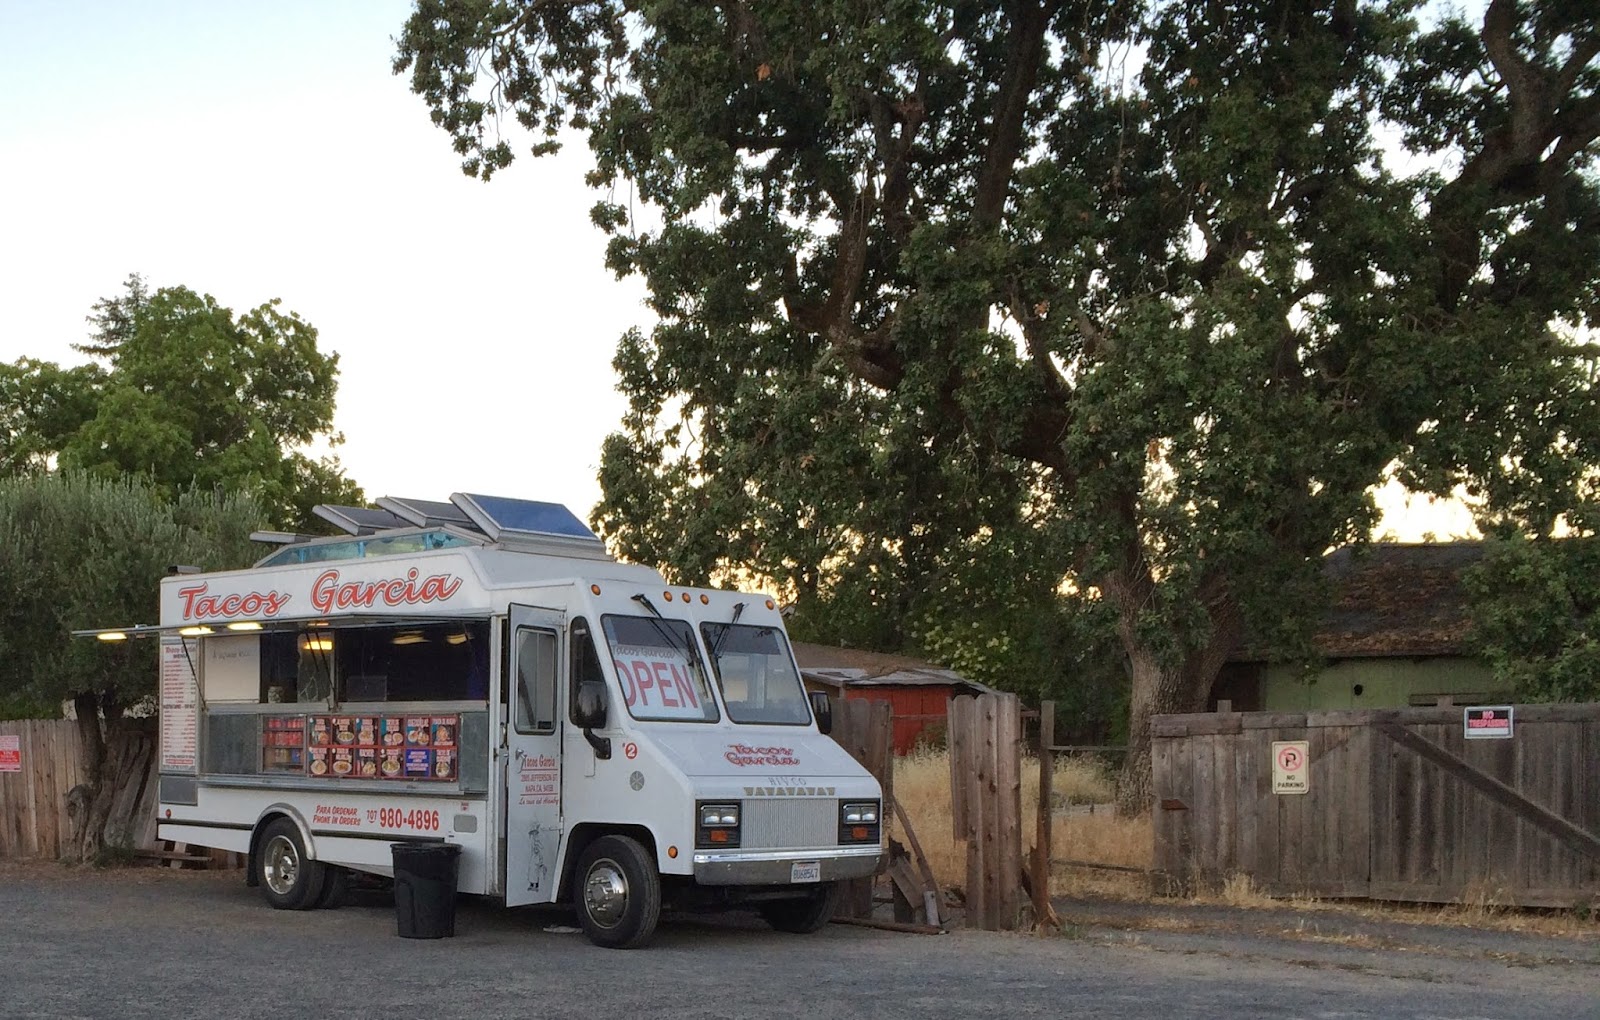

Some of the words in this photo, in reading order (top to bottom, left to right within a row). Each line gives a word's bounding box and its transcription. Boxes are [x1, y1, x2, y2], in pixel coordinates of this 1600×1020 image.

[178, 581, 292, 620] Tacos
[310, 567, 464, 615] Garcia
[615, 660, 698, 708] OPEN
[1482, 710, 1494, 719] NO
[1468, 719, 1508, 727] TRESPASSING
[627, 744, 636, 757] 2
[724, 752, 800, 767] Garcia
[315, 805, 331, 814] PARA
[332, 806, 357, 816] ORDENAR
[313, 814, 331, 824] PHONE
[332, 815, 339, 824] IN
[340, 816, 361, 826] ORDERS
[367, 810, 377, 820] 707
[380, 808, 439, 831] 980-4896
